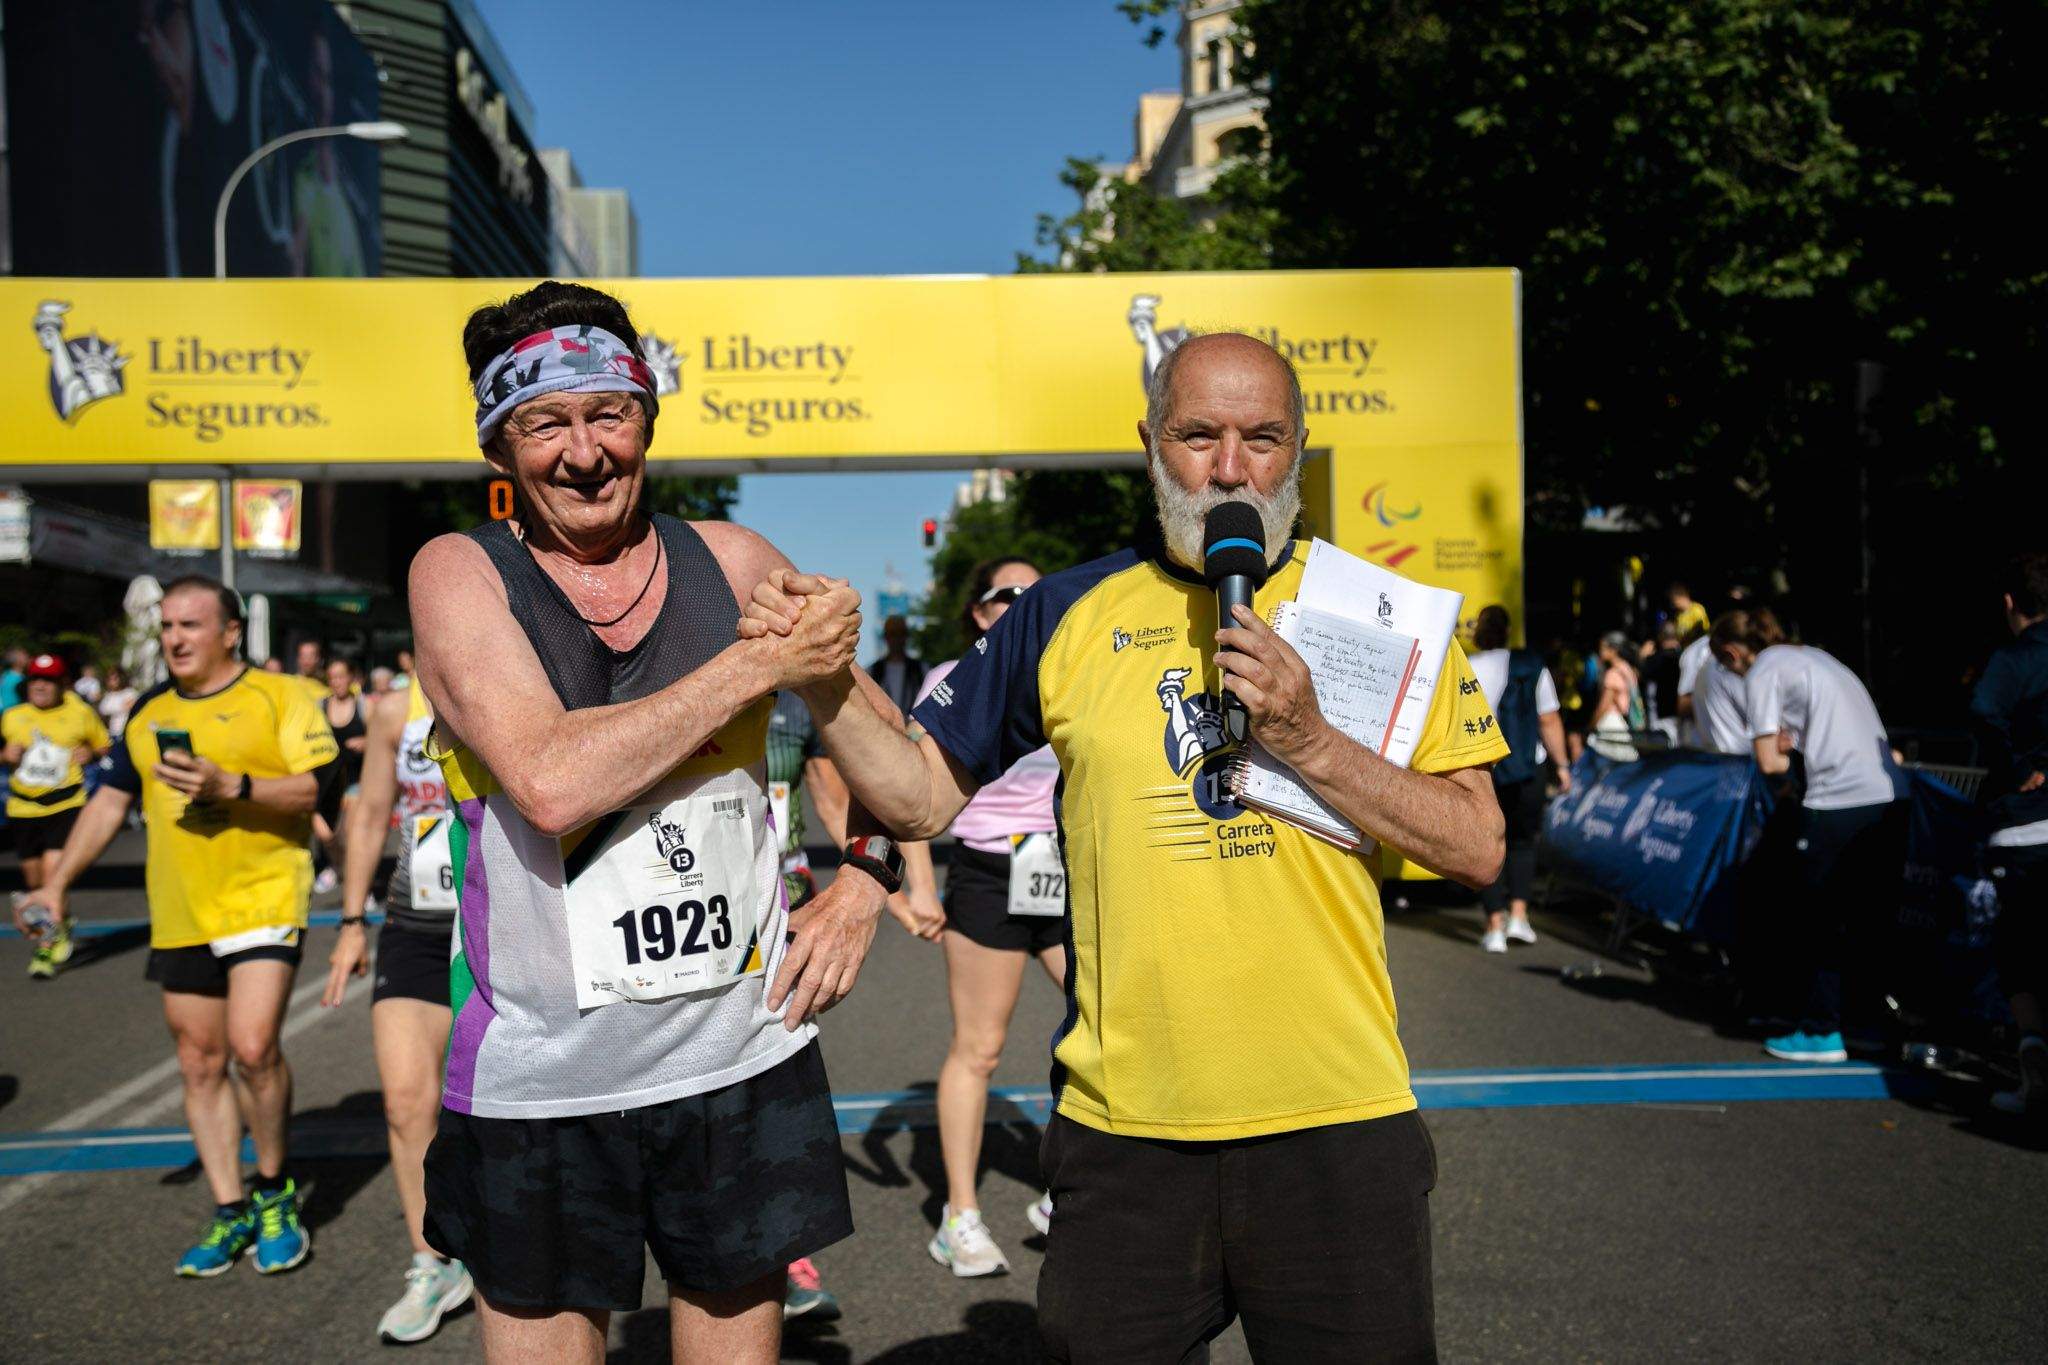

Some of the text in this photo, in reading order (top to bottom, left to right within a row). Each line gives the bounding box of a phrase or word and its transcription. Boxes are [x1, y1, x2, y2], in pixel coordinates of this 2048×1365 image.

[149, 336, 313, 390] Liberty
[702, 334, 853, 384] Liberty
[1258, 327, 1378, 377] berty
[701, 388, 872, 437] Seguros.
[1303, 390, 1396, 414] uros.
[147, 391, 331, 443] Seguros.
[1133, 637, 1177, 650] Seguros.
[1136, 626, 1175, 637] Liberty
[1216, 822, 1274, 840] Carrera
[673, 852, 691, 868] 13
[1219, 841, 1276, 859] Liberty
[680, 872, 703, 881] Carrera
[681, 879, 704, 888] Liberty
[1030, 872, 1063, 897] 372
[613, 894, 733, 965] 1923
